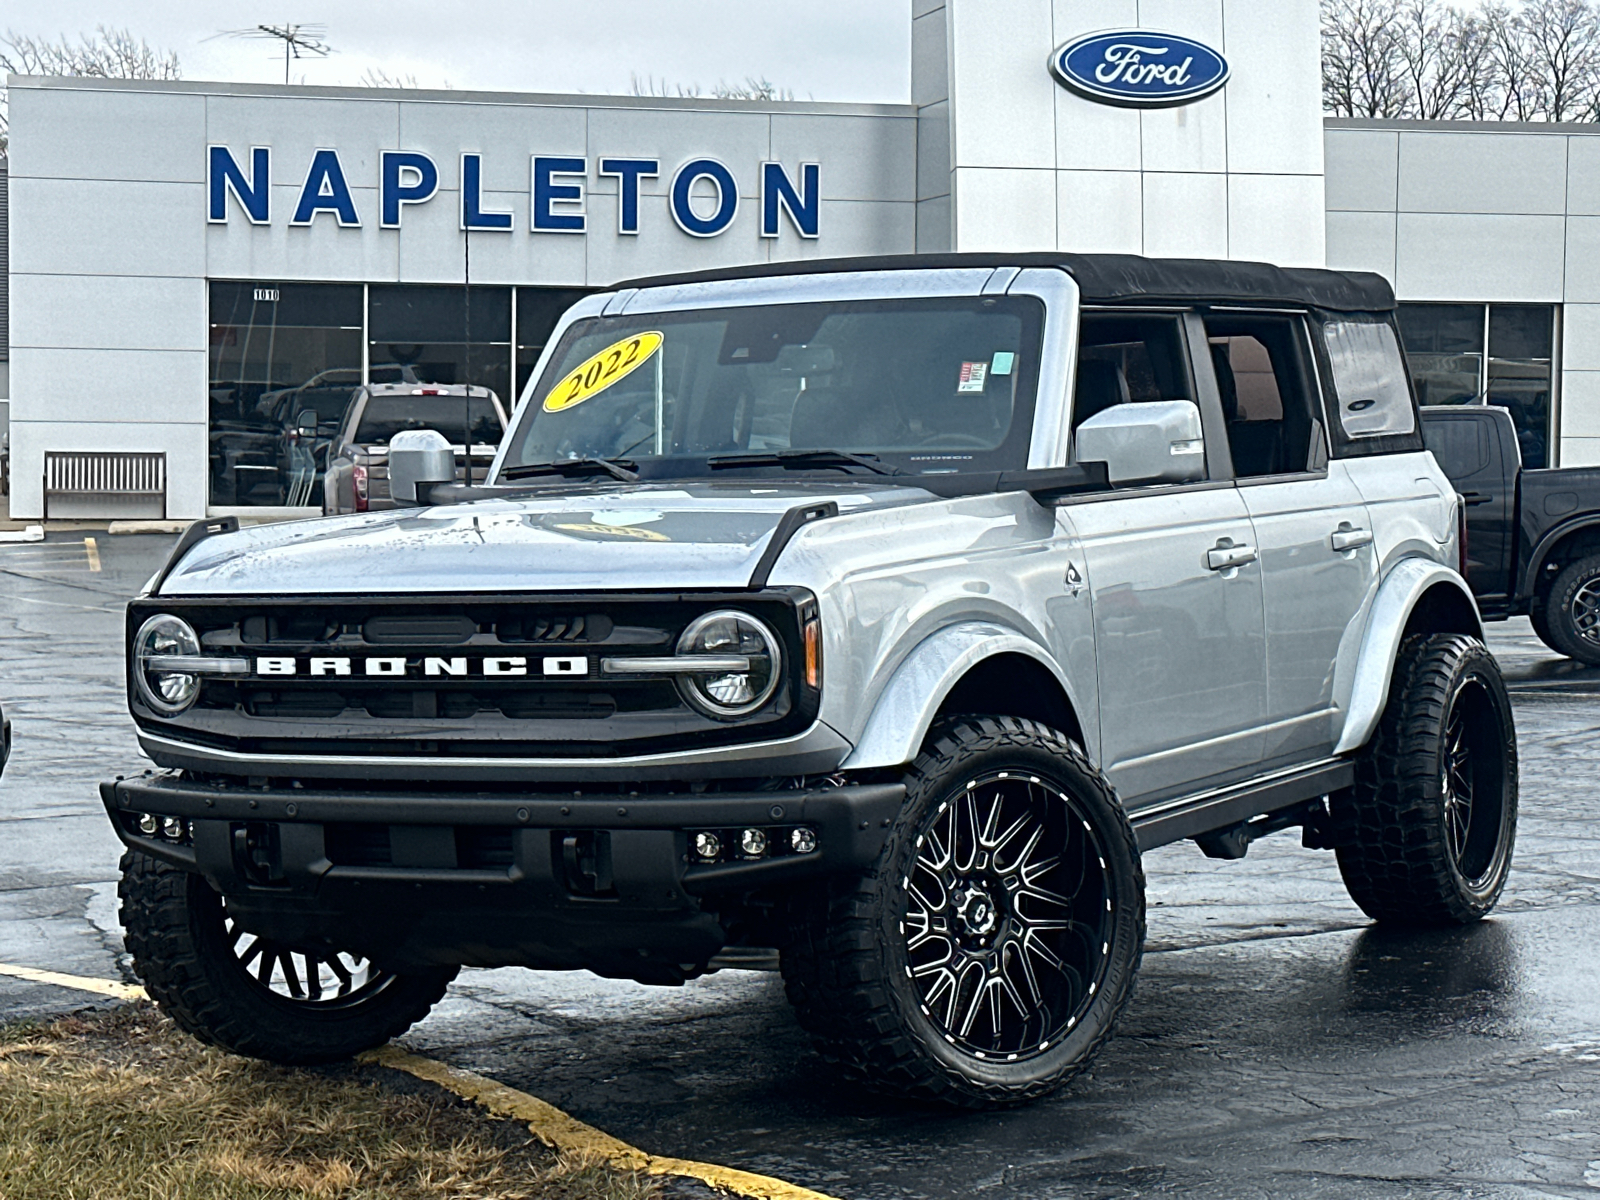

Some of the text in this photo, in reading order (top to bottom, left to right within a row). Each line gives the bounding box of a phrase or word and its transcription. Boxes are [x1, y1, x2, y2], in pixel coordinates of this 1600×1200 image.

[1095, 43, 1193, 85] Ford
[206, 144, 820, 238] NAPLETON
[255, 289, 278, 300] 1010
[564, 339, 641, 404] 2022
[256, 656, 588, 676] BRONCO
